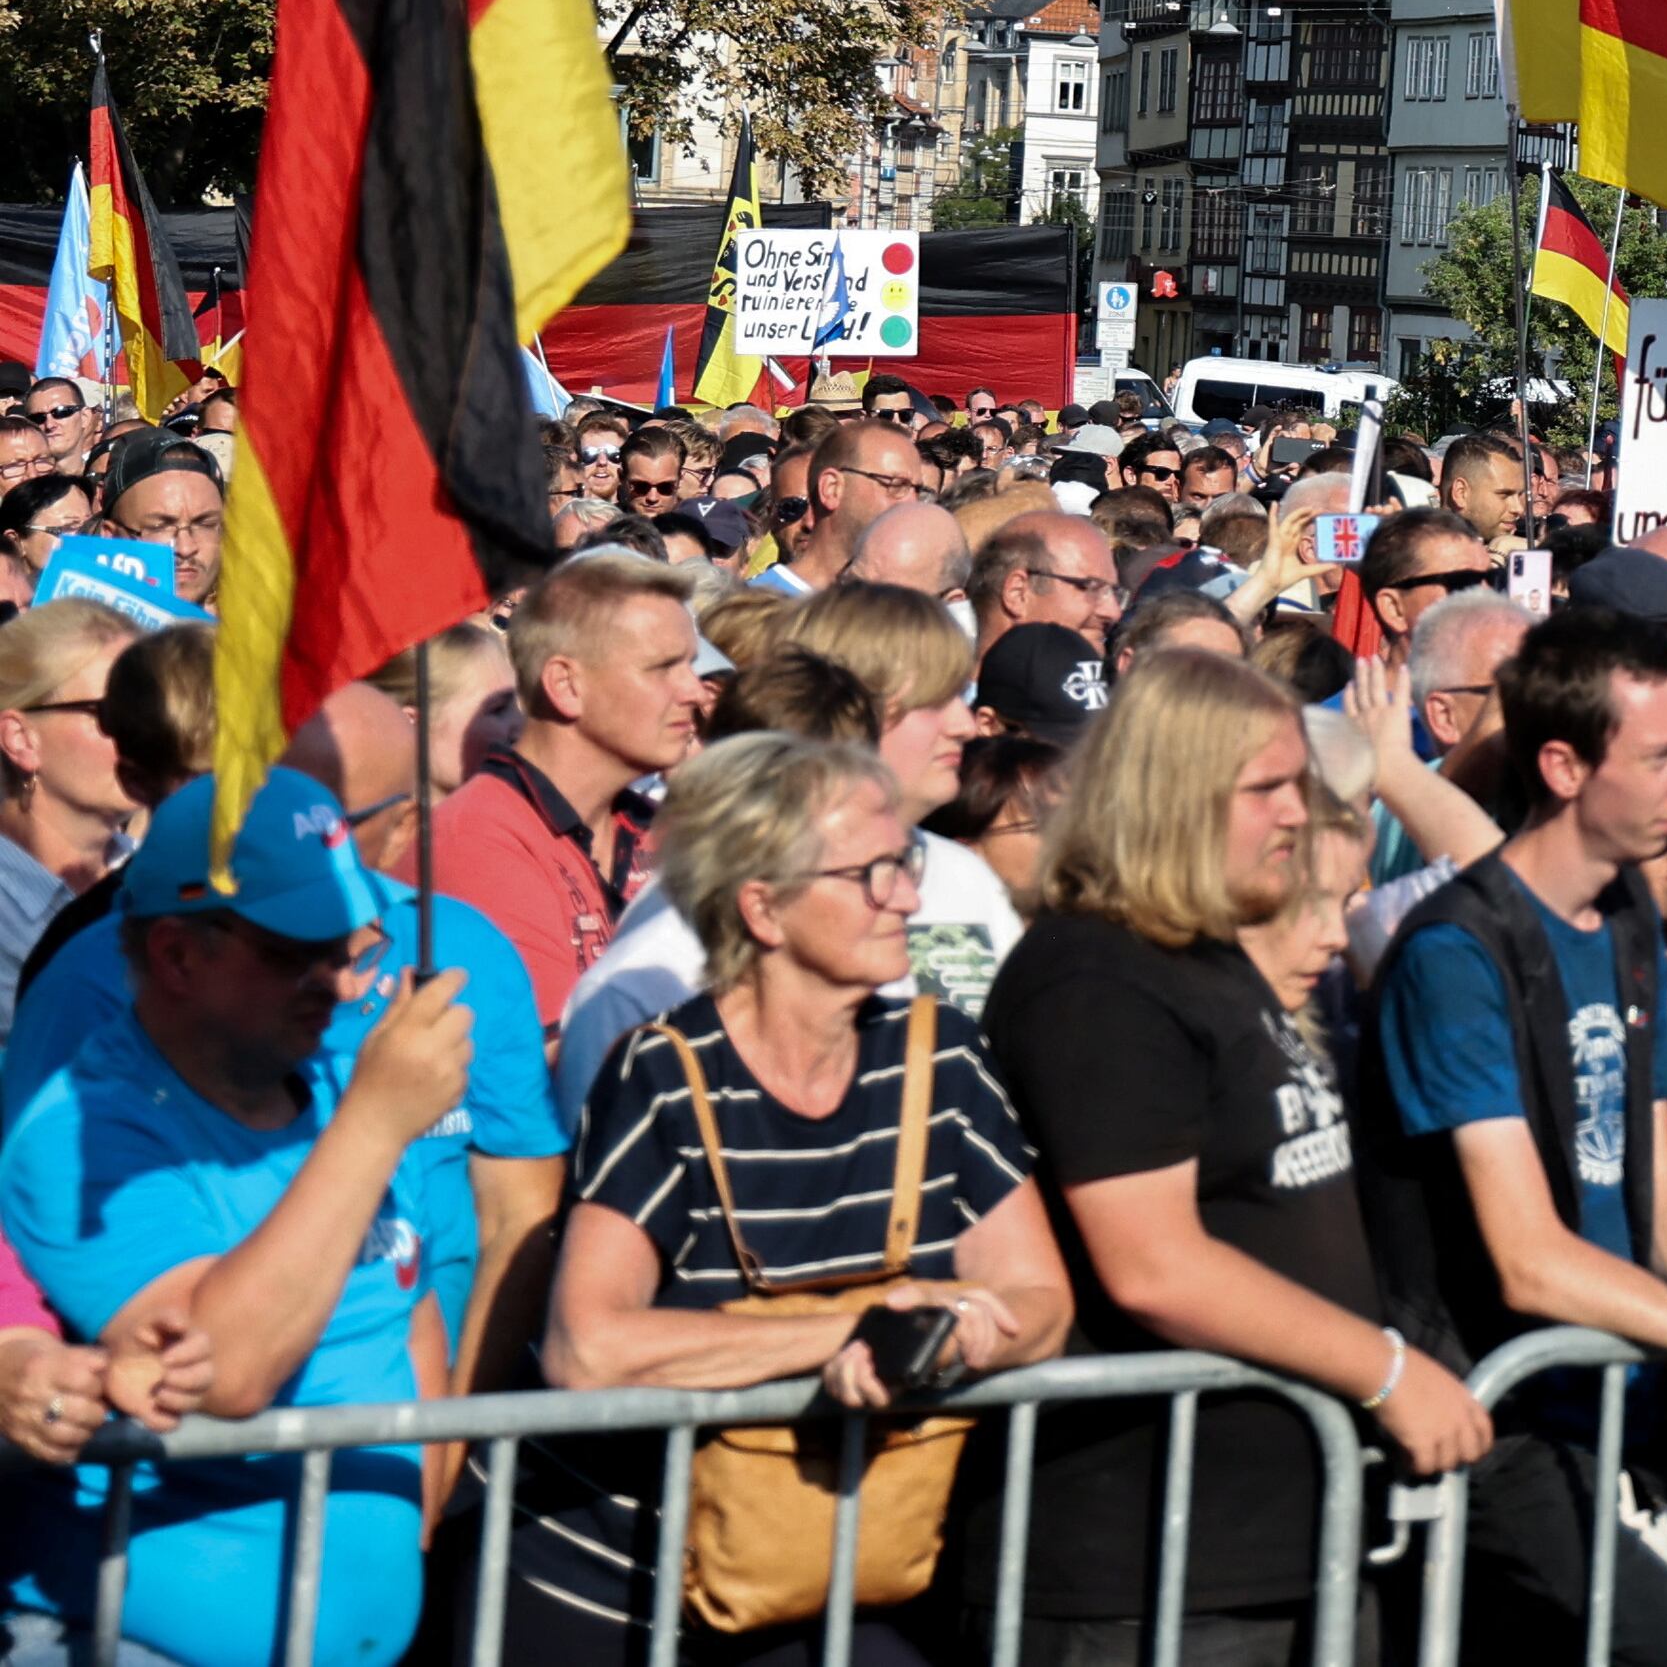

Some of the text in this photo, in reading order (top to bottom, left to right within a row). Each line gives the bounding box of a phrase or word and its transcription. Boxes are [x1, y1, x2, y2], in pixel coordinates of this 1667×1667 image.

[745, 239, 832, 269] Ohne Sin
[746, 271, 778, 288] und
[744, 316, 797, 339] unser
